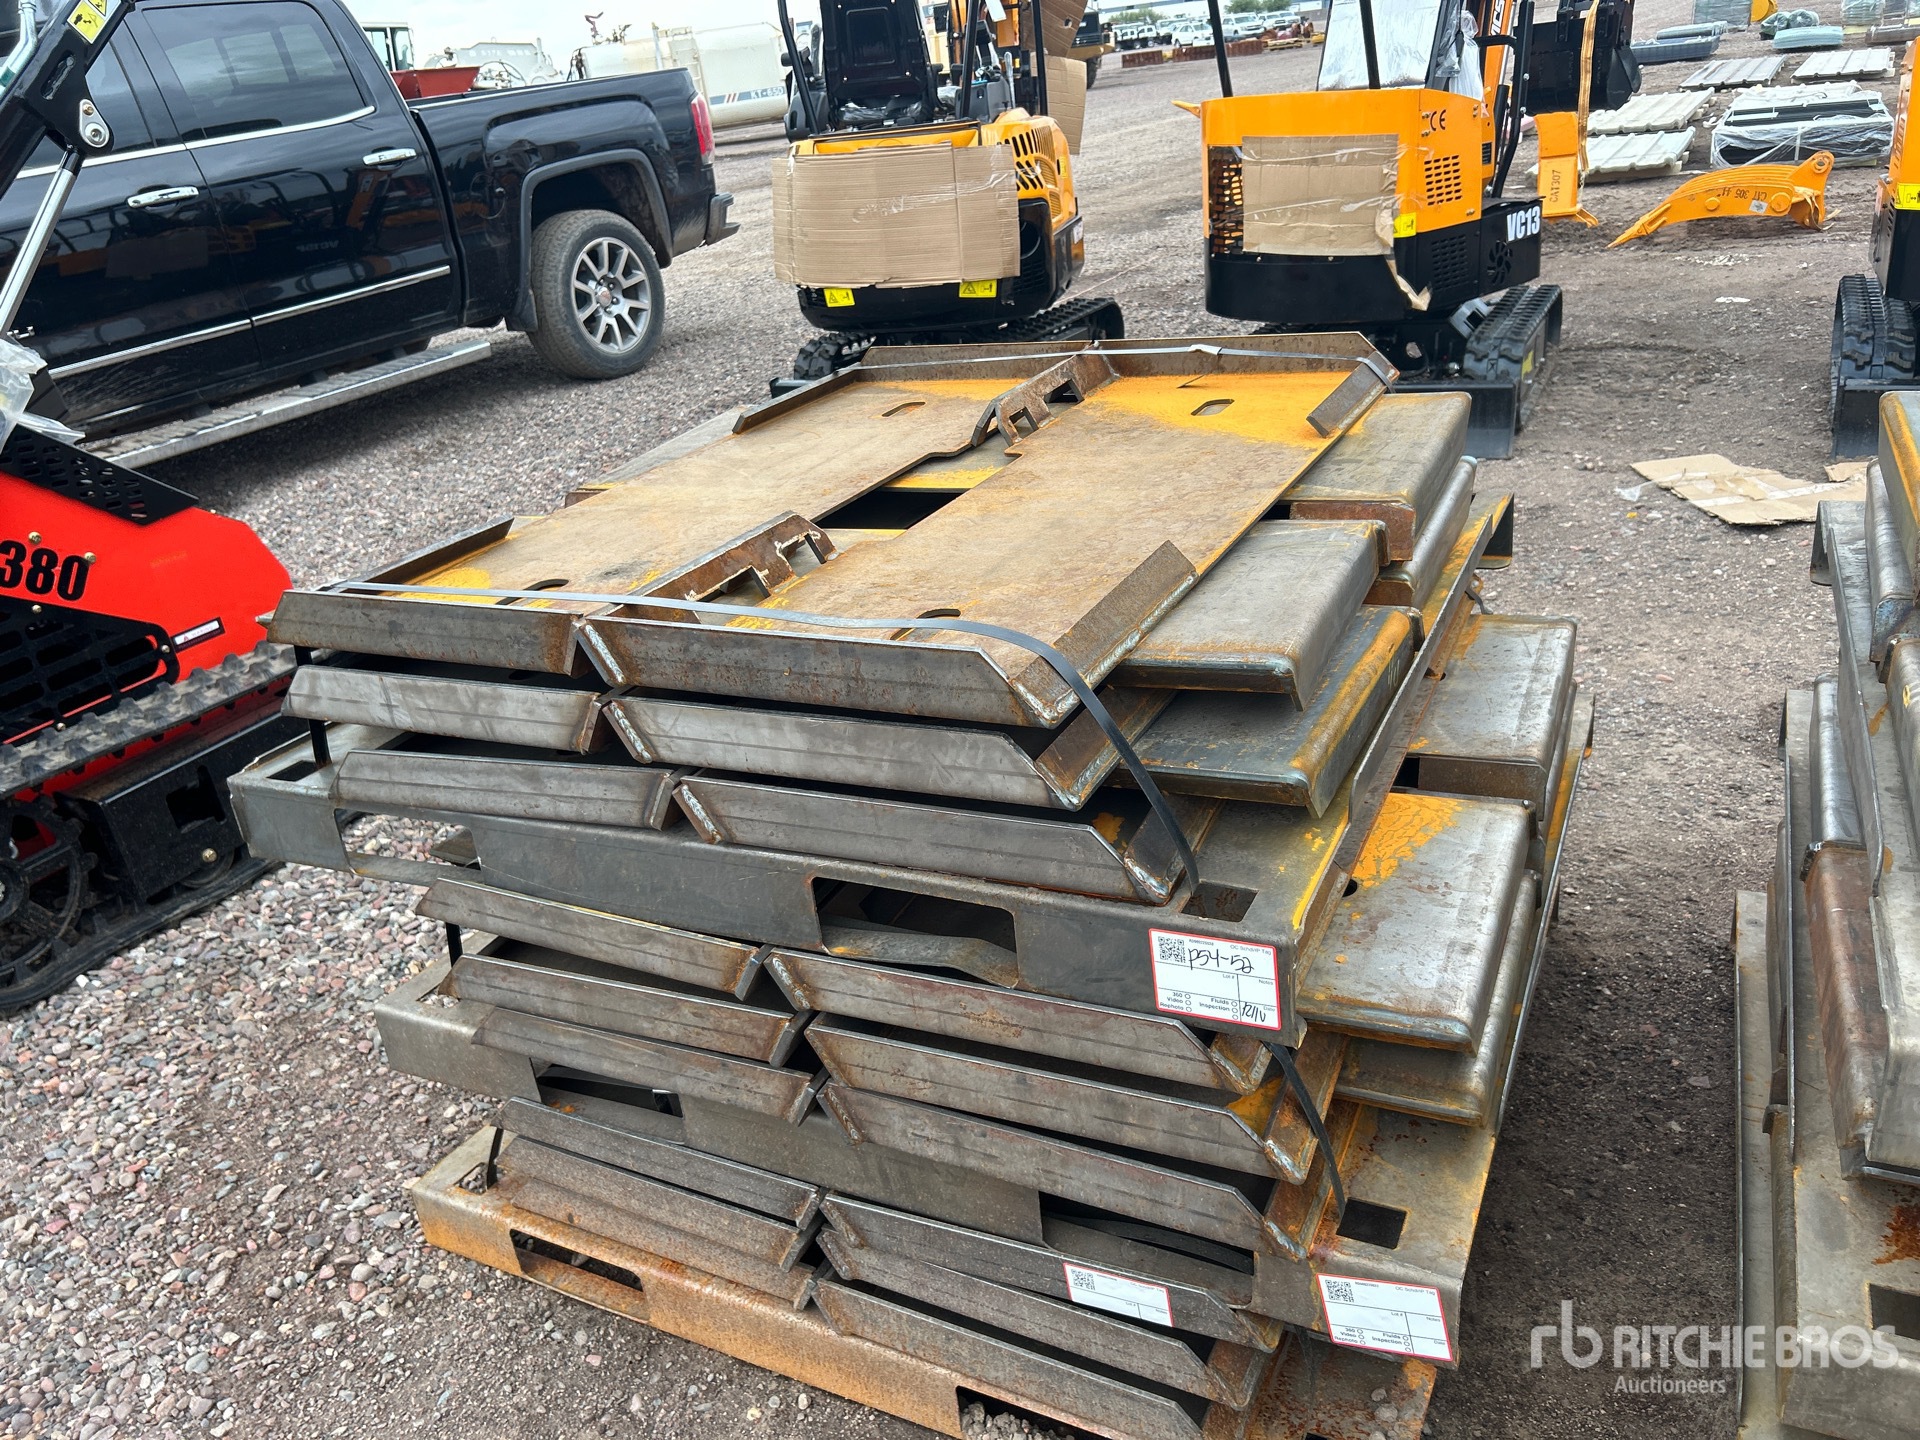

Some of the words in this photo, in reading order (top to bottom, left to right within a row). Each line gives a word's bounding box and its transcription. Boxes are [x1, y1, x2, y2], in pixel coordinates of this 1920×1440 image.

[1506, 205, 1541, 242] VC13
[0, 539, 91, 602] 380
[1166, 996, 1184, 1004] Video
[1210, 997, 1230, 1005] Fluids
[1199, 1002, 1230, 1012] Inspection
[1371, 1336, 1402, 1345] Inspection
